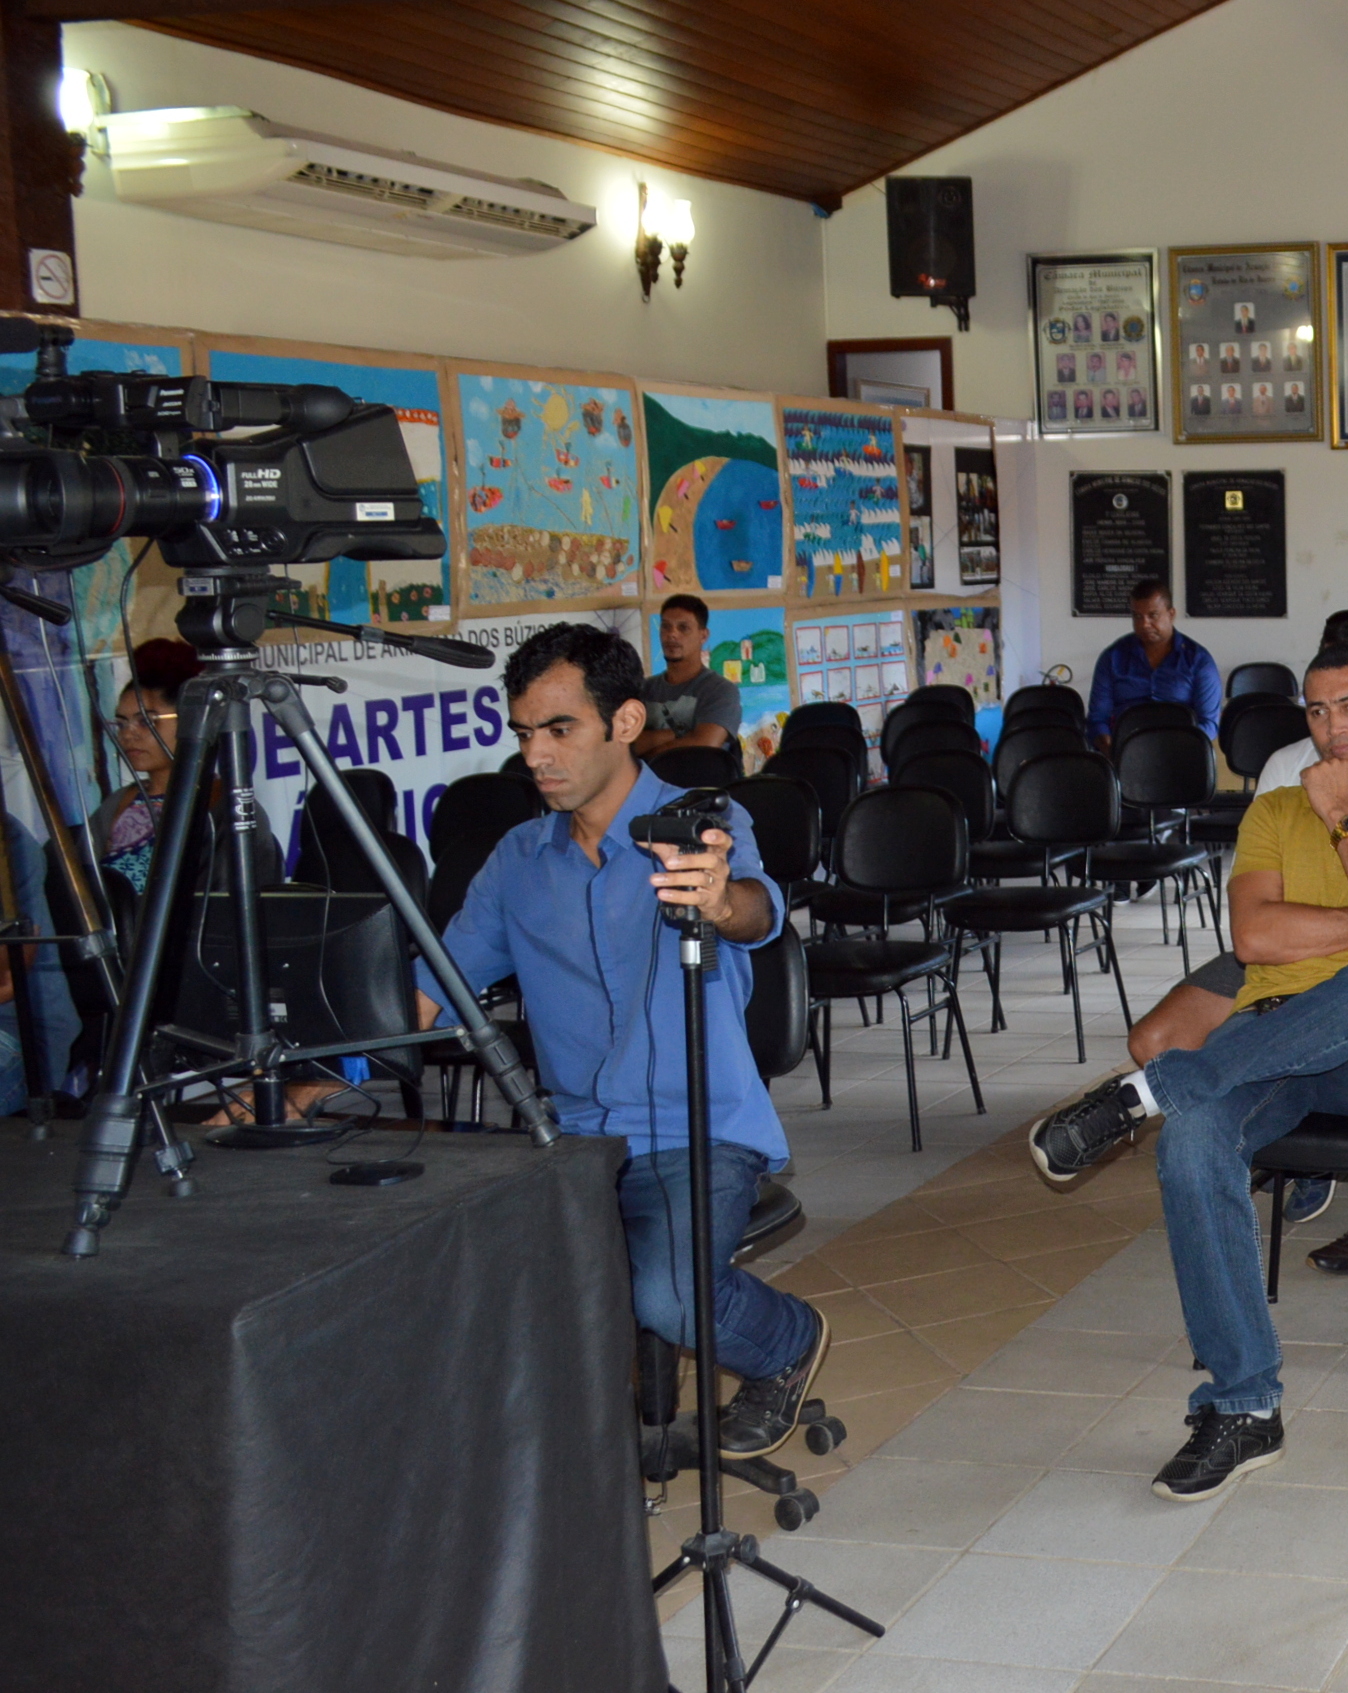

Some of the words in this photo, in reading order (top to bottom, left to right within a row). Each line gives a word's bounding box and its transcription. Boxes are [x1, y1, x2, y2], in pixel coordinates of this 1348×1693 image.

[257, 468, 282, 479] HD
[354, 640, 377, 661] DE
[468, 627, 500, 648] DOS
[504, 620, 554, 647] BÚZ
[327, 685, 503, 768] ARTES
